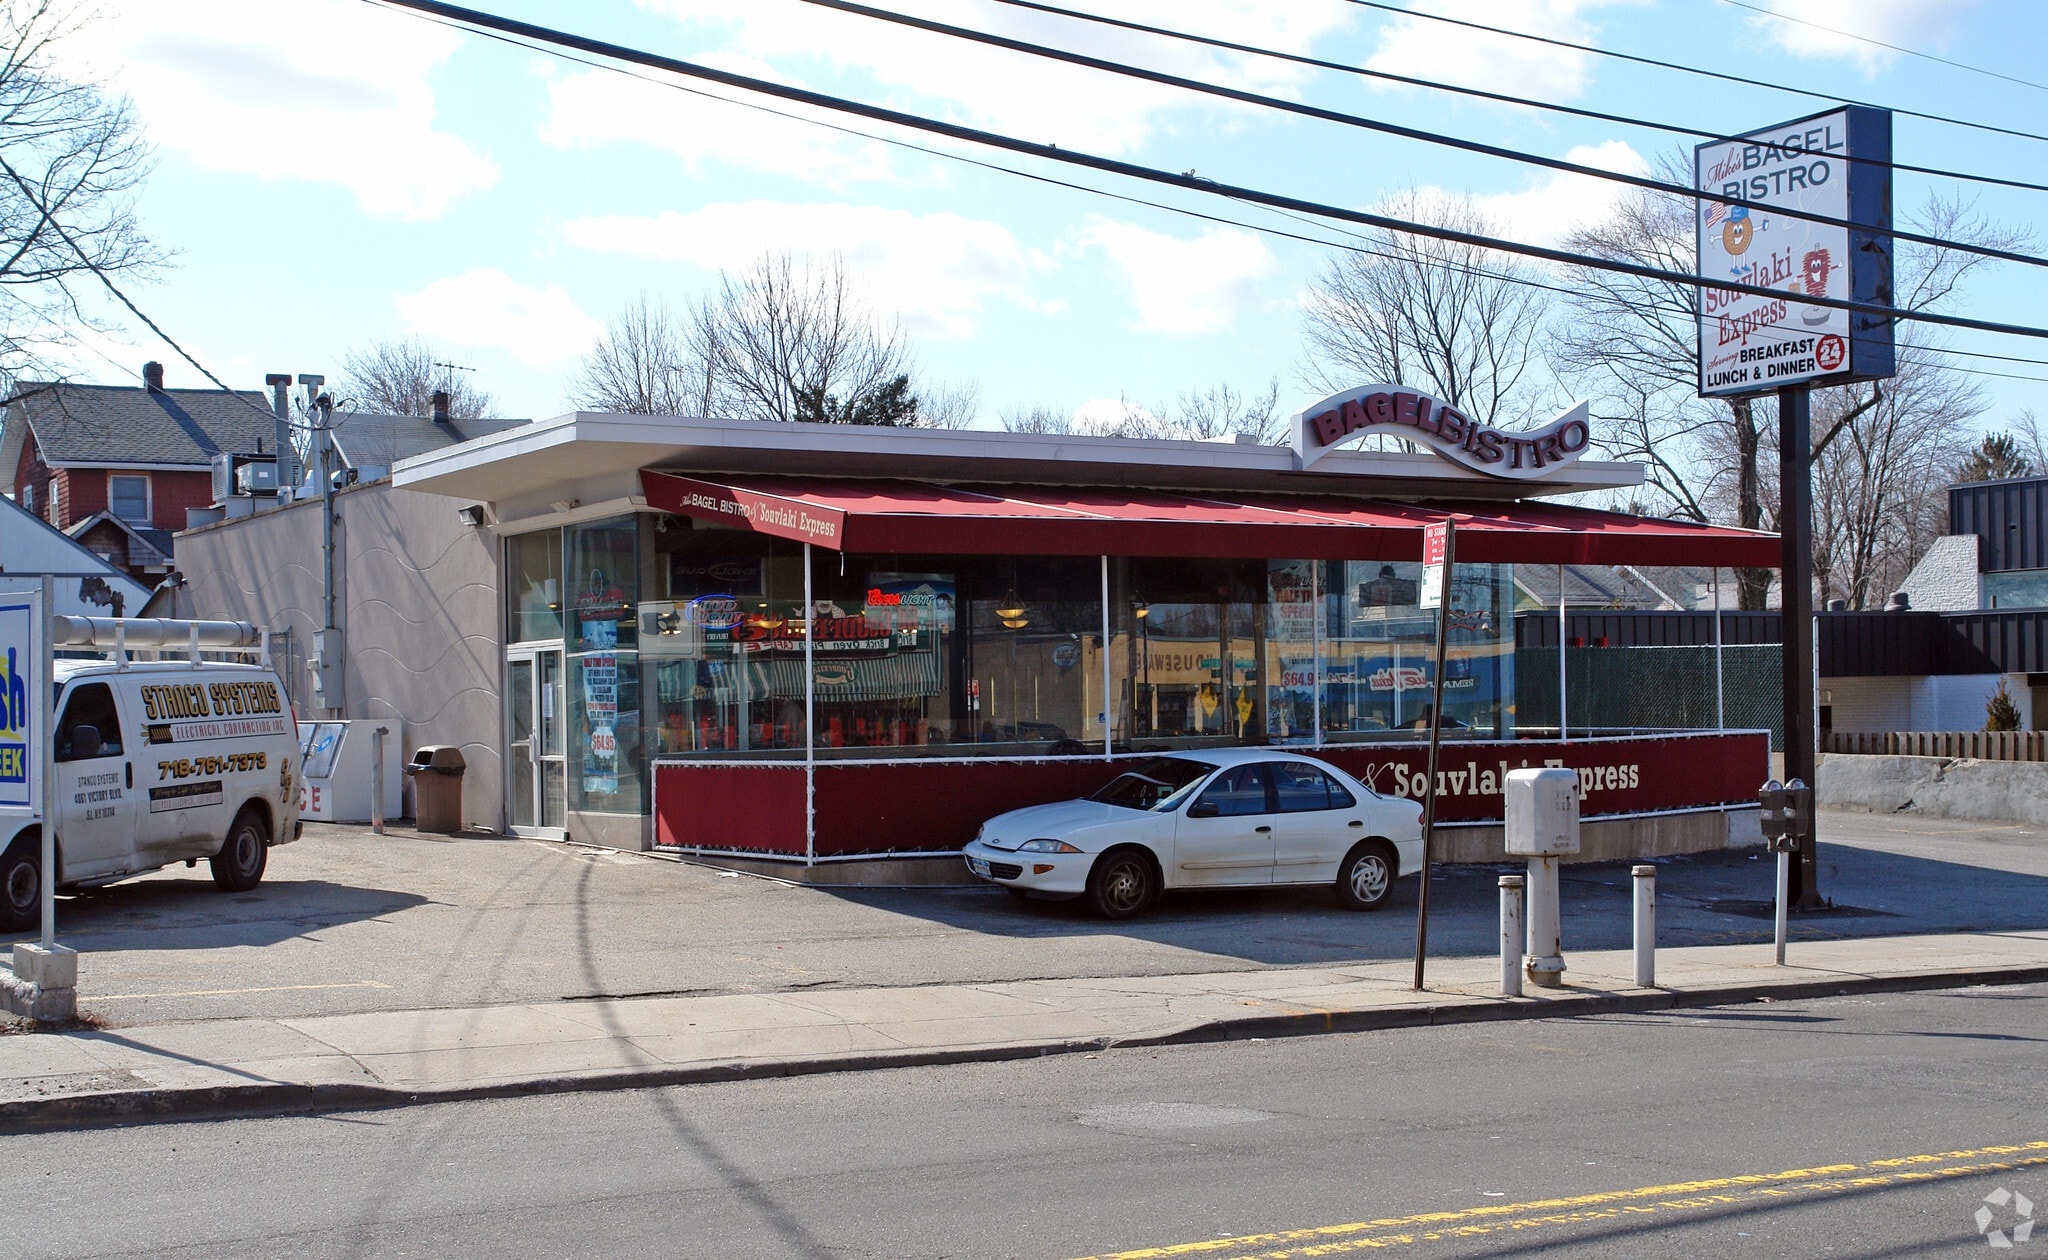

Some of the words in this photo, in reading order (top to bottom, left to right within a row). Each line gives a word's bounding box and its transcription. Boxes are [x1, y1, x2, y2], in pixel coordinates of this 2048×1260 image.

[1703, 147, 1742, 191] Mike's
[1743, 126, 1844, 171] BAGEL
[1723, 161, 1830, 201] BISTRO
[1718, 299, 1787, 347] Express
[1706, 352, 1738, 371] Serving
[1740, 338, 1815, 363] BREAKFAST
[1820, 342, 1841, 361] 24
[1707, 368, 1748, 387] LUNCH
[1753, 366, 1761, 380] &
[1767, 358, 1815, 377] DINNER
[1311, 391, 1440, 447] BAGEL
[1435, 406, 1590, 469] BISTRO
[691, 493, 718, 511] BAGEL
[719, 499, 750, 518] BISTRO
[759, 503, 798, 529] Souvlaki
[799, 511, 835, 537] Express
[700, 600, 737, 612] BUD
[867, 589, 901, 606] Coors
[900, 595, 935, 605] LIGHT
[141, 683, 210, 720] STANCO
[208, 681, 282, 716] SYSTEMS
[176, 722, 222, 739] ELECTRICAL
[223, 719, 271, 736] CONTRACTING
[591, 734, 615, 751] $64.95
[97, 773, 119, 786] SYSTEMS
[158, 752, 267, 781] 718-761-7373
[1394, 759, 1528, 797] Souvla
[1544, 758, 1640, 801] press
[88, 789, 109, 802] VICTORY
